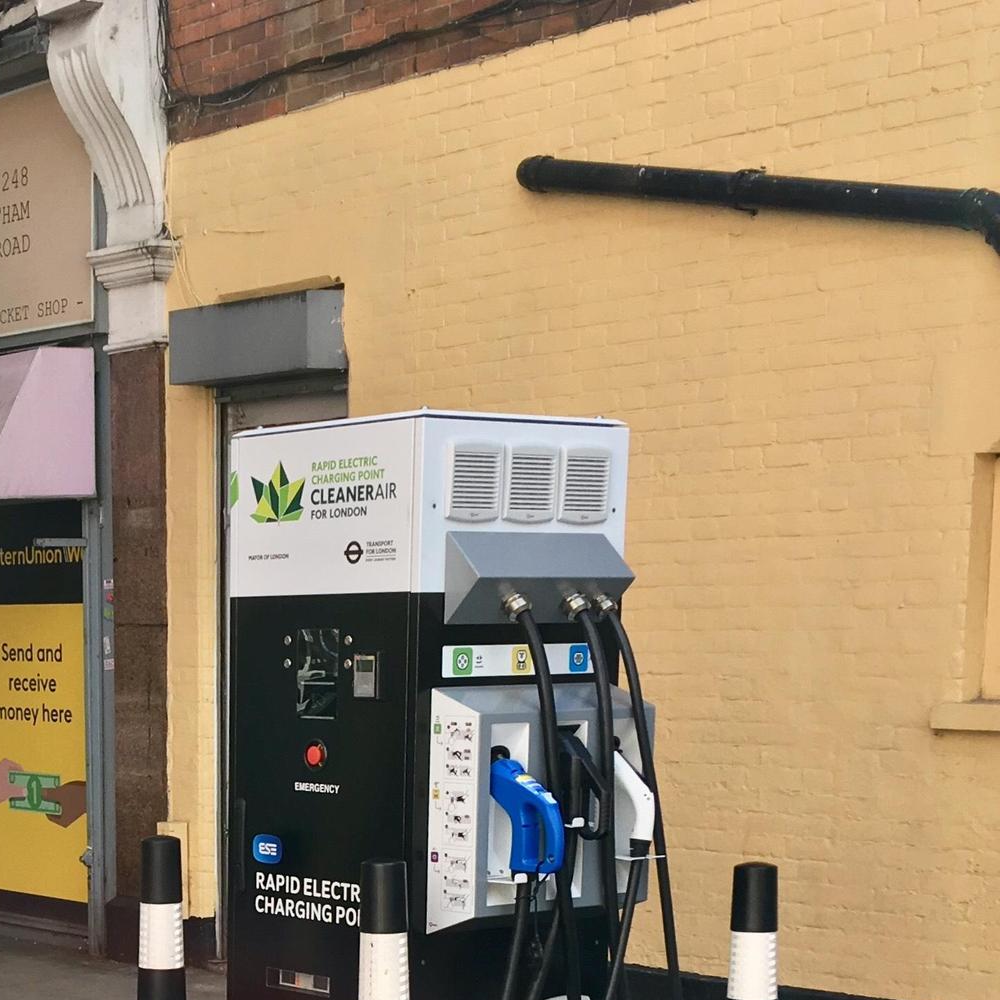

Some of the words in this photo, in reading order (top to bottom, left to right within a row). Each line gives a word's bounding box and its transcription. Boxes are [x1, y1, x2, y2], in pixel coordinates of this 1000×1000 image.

[2, 166, 29, 192] 248
[37, 298, 68, 318] SHOP
[311, 460, 336, 472] RAPID
[339, 455, 378, 469] ELECTRIC
[311, 471, 356, 485] CHARGING
[358, 468, 385, 480] POINT
[311, 509, 327, 520] FOR
[330, 506, 367, 519] LONDON
[1, 642, 33, 662] Send
[36, 643, 63, 662] and
[8, 673, 57, 692] receive
[42, 703, 73, 723] here
[294, 781, 340, 794] EMERGENCY
[255, 871, 301, 894] RAPID
[303, 877, 360, 903] ELECTR
[255, 895, 333, 923] CHARGING
